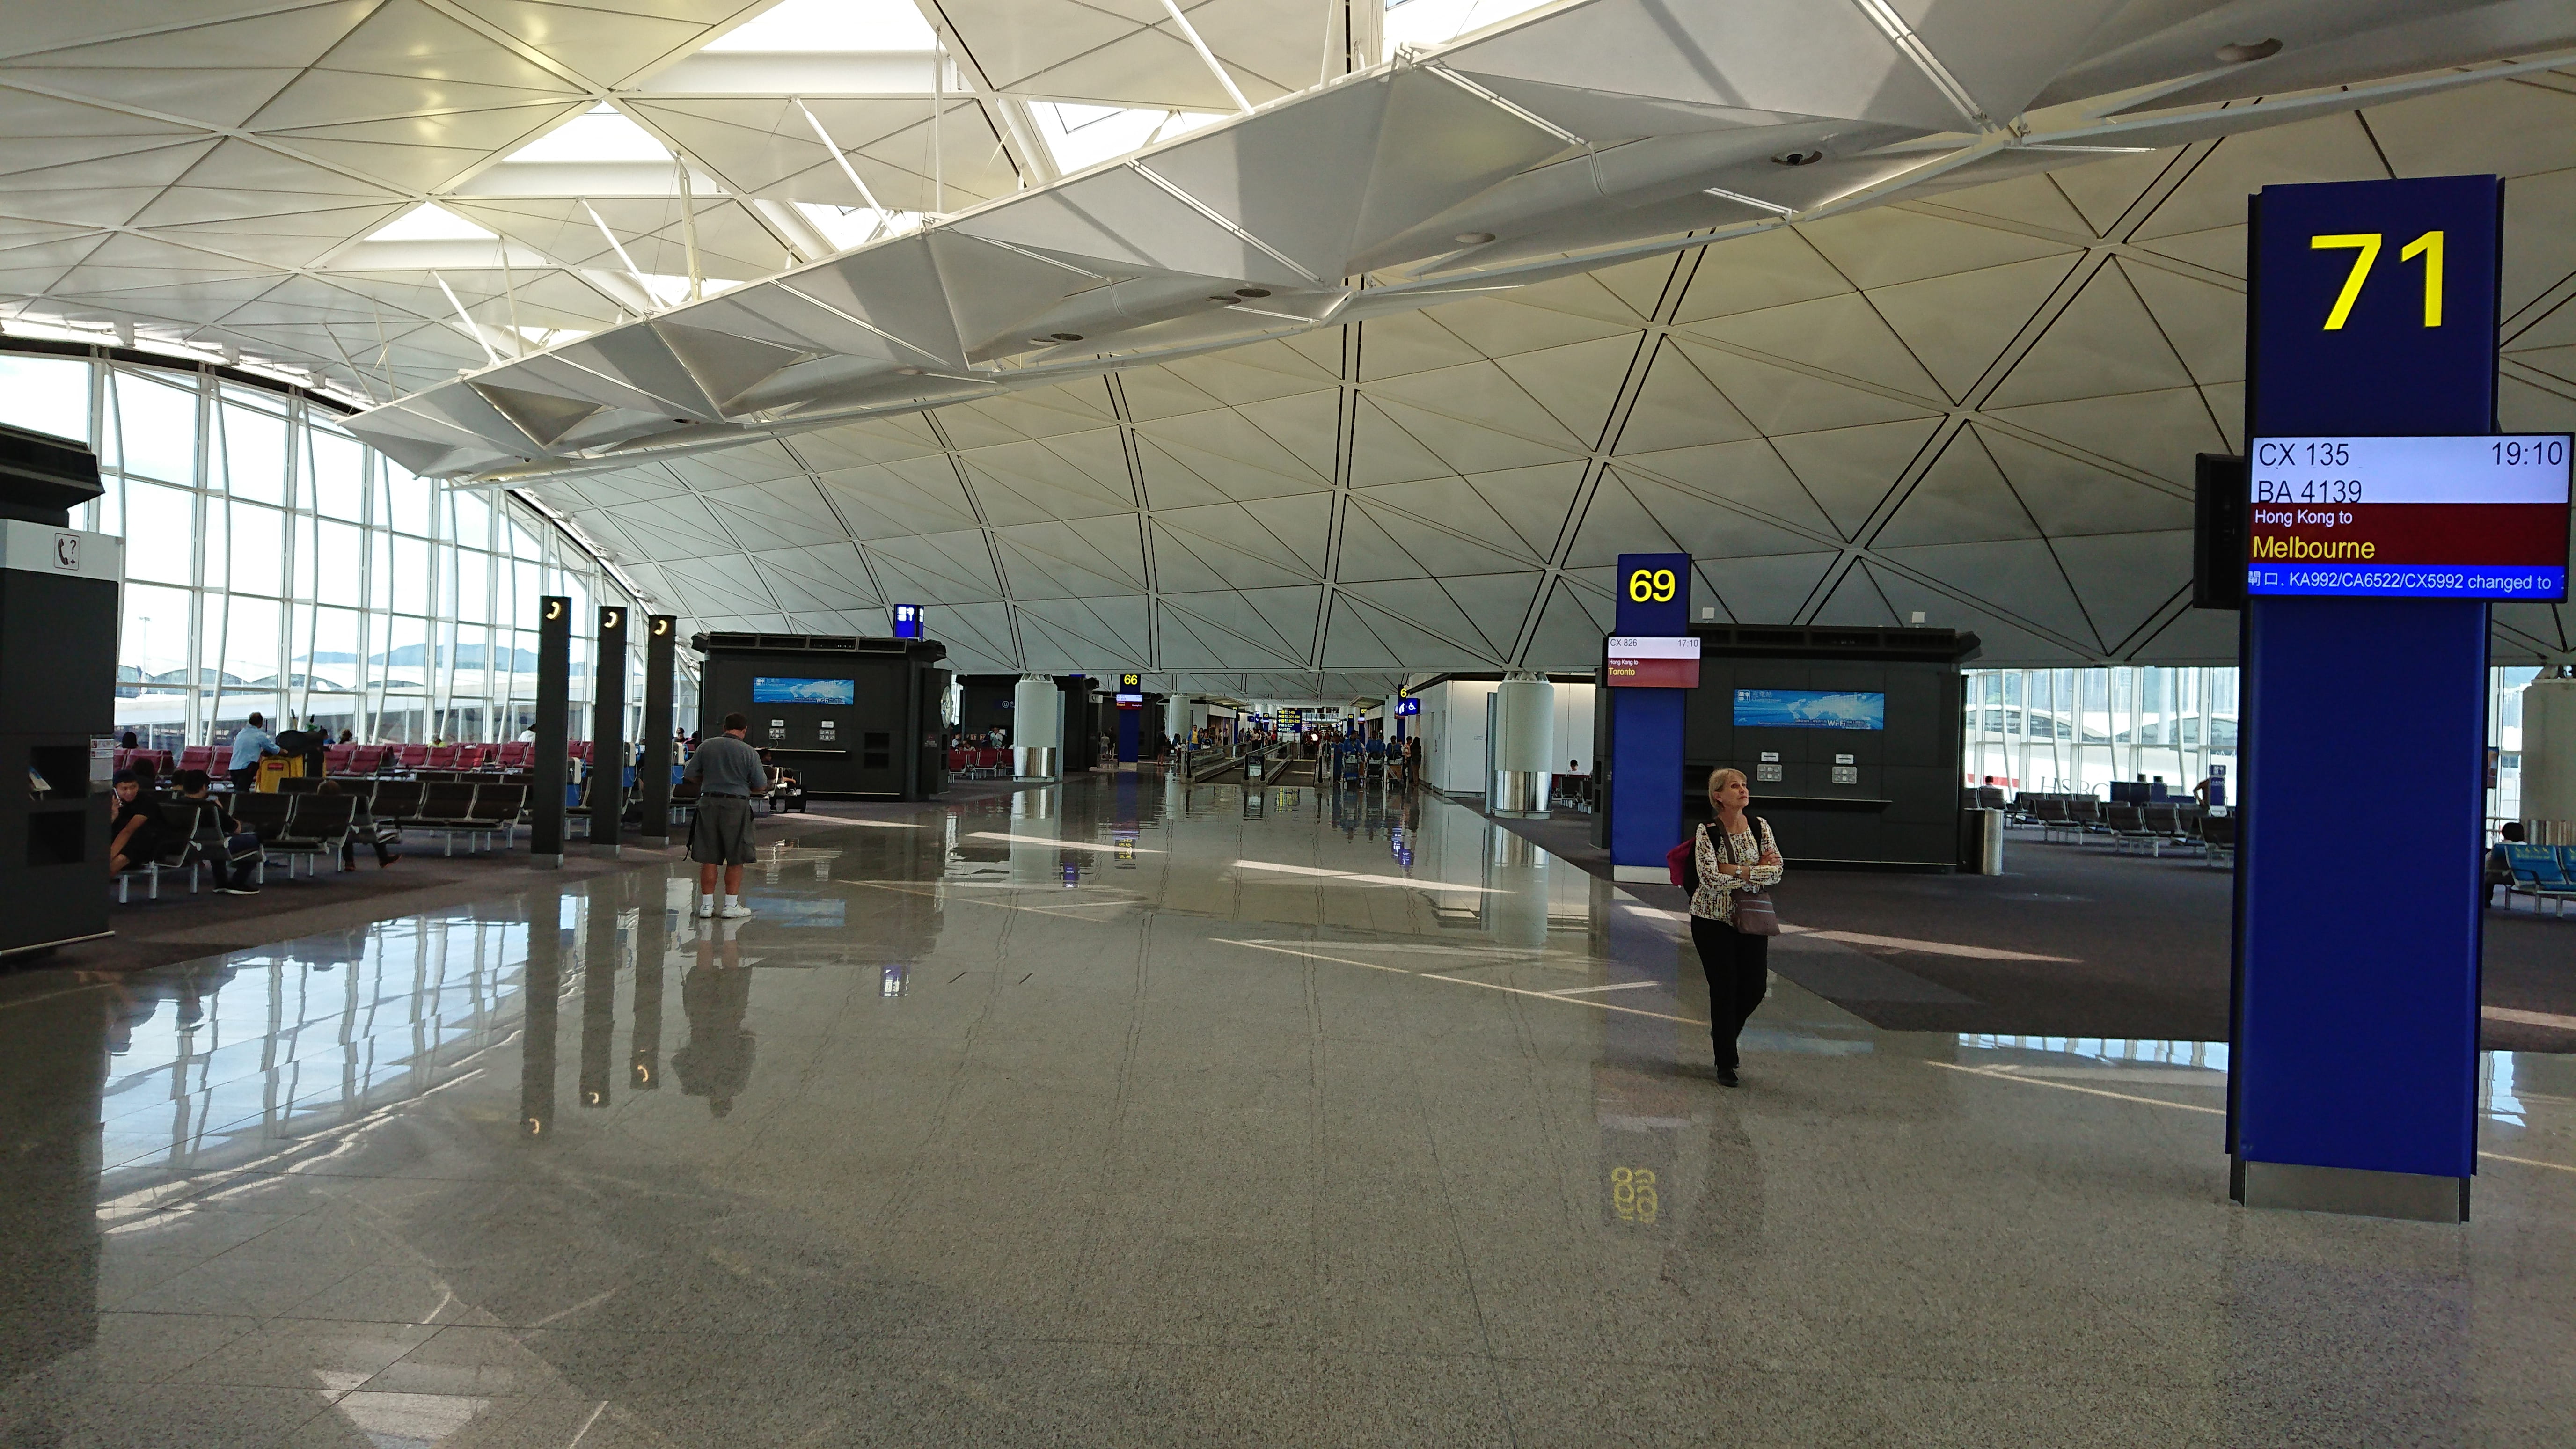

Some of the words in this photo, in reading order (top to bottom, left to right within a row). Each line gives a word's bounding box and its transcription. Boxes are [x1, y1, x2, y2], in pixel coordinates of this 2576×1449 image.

[2311, 231, 2444, 330] 71
[2260, 443, 2296, 466] CX
[2306, 443, 2349, 466] 135
[2492, 441, 2563, 465] 19:10
[2258, 480, 2293, 503] BA
[2301, 480, 2362, 503] 4139
[2254, 509, 2293, 527] Hong
[2297, 509, 2334, 527] Kong
[2339, 510, 2353, 524] to
[2253, 535, 2376, 559] Melbourne
[1630, 569, 1676, 602] 69
[2290, 571, 2464, 589] KA992/CA6522/CX5992
[2467, 574, 2532, 593] changed
[2537, 575, 2552, 590] to
[1610, 638, 1622, 647] CX
[1624, 638, 1637, 647] 826
[1124, 674, 1138, 685] 66
[1608, 667, 1635, 676] Toronto
